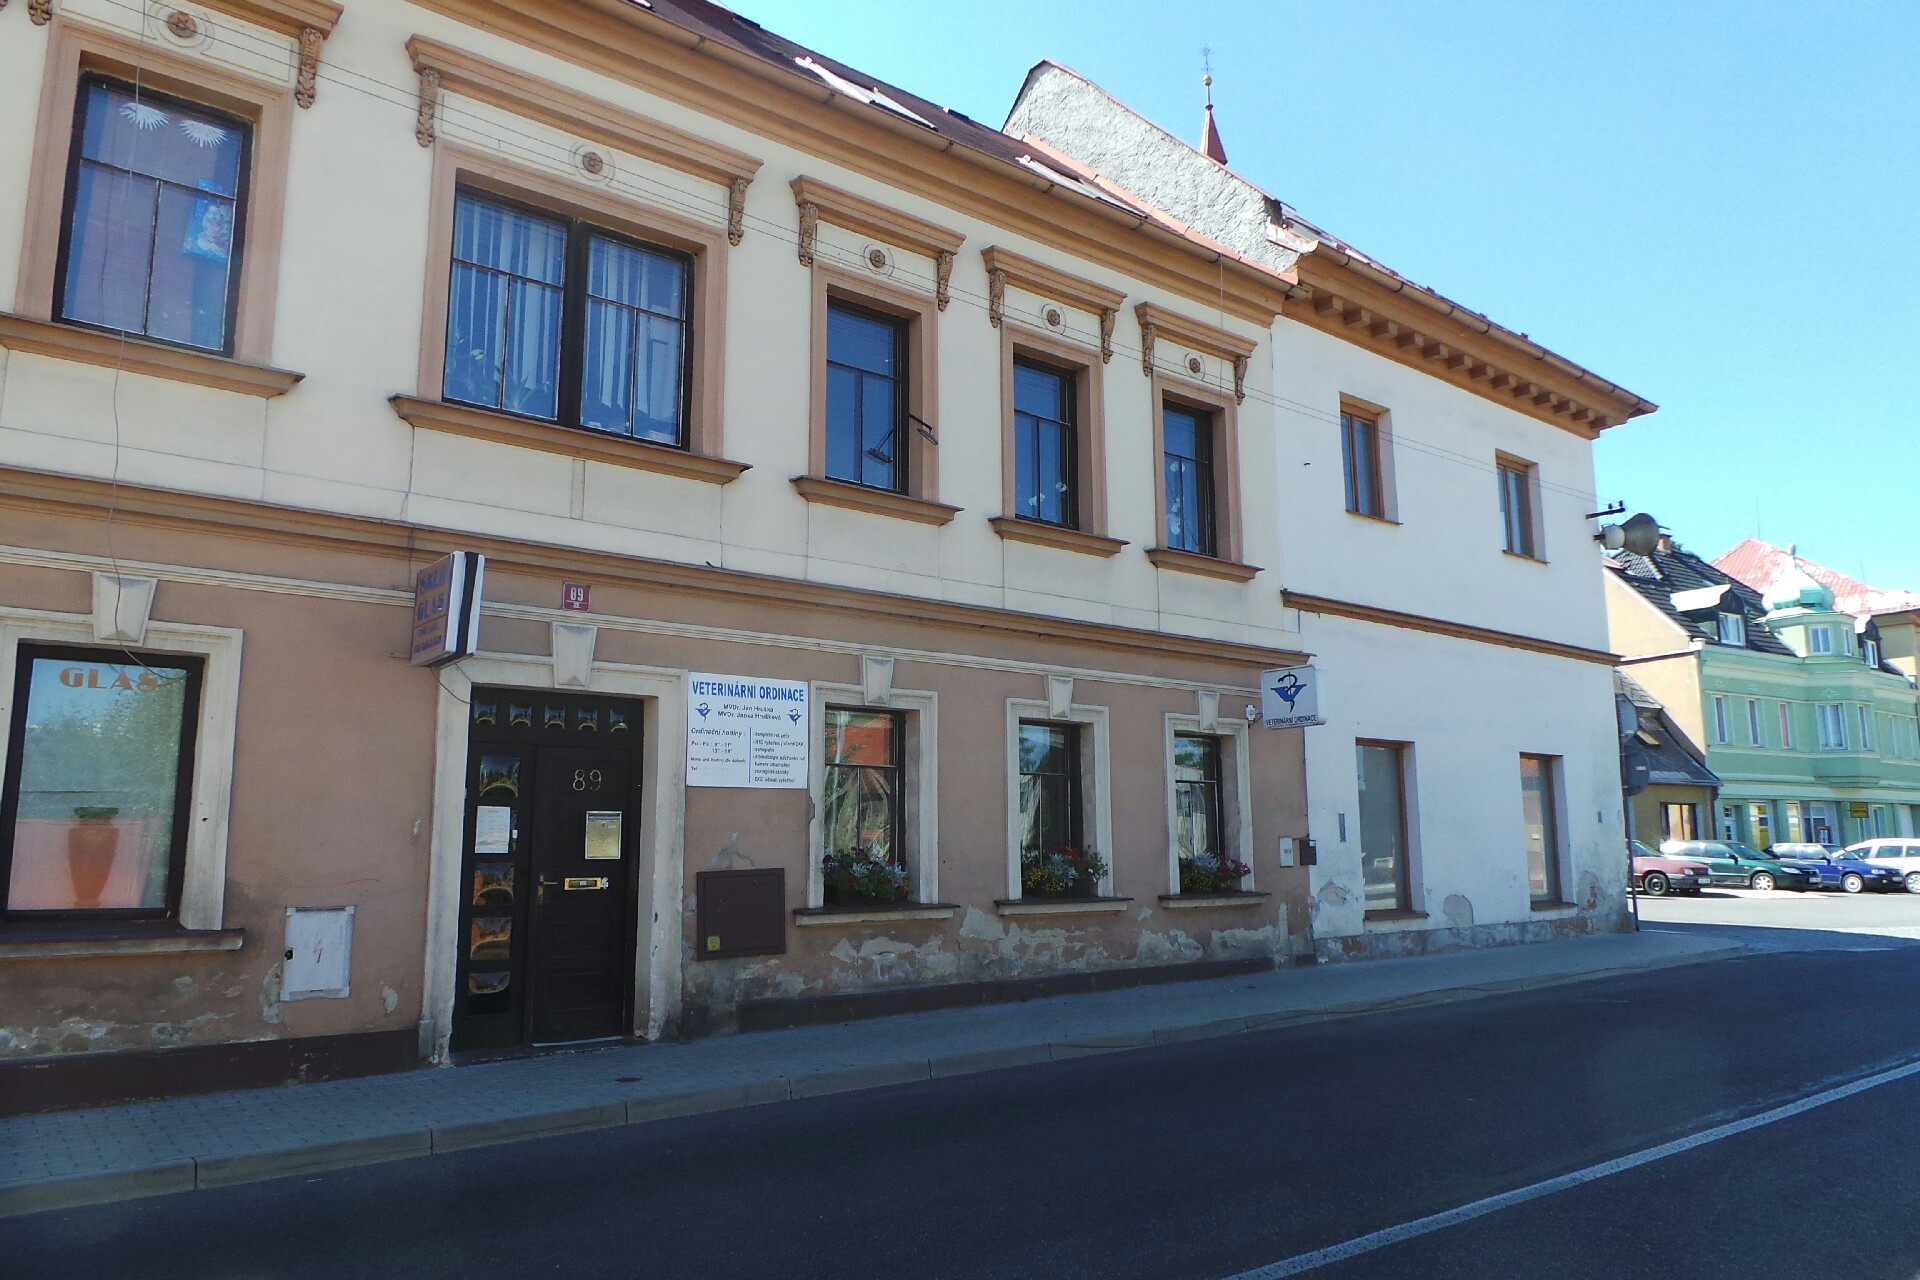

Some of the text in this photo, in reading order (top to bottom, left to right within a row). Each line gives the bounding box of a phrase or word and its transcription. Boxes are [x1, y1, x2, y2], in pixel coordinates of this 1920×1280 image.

[570, 587, 584, 601] 89
[60, 667, 159, 692] GLAS
[692, 680, 805, 702] VETERINÁRNÍ ORDINACE
[754, 705, 774, 713] Hruška
[1265, 714, 1317, 726] VETERINÁRNÍ ORDINACE
[691, 727, 721, 736] Ordinační
[573, 769, 602, 791] 89
